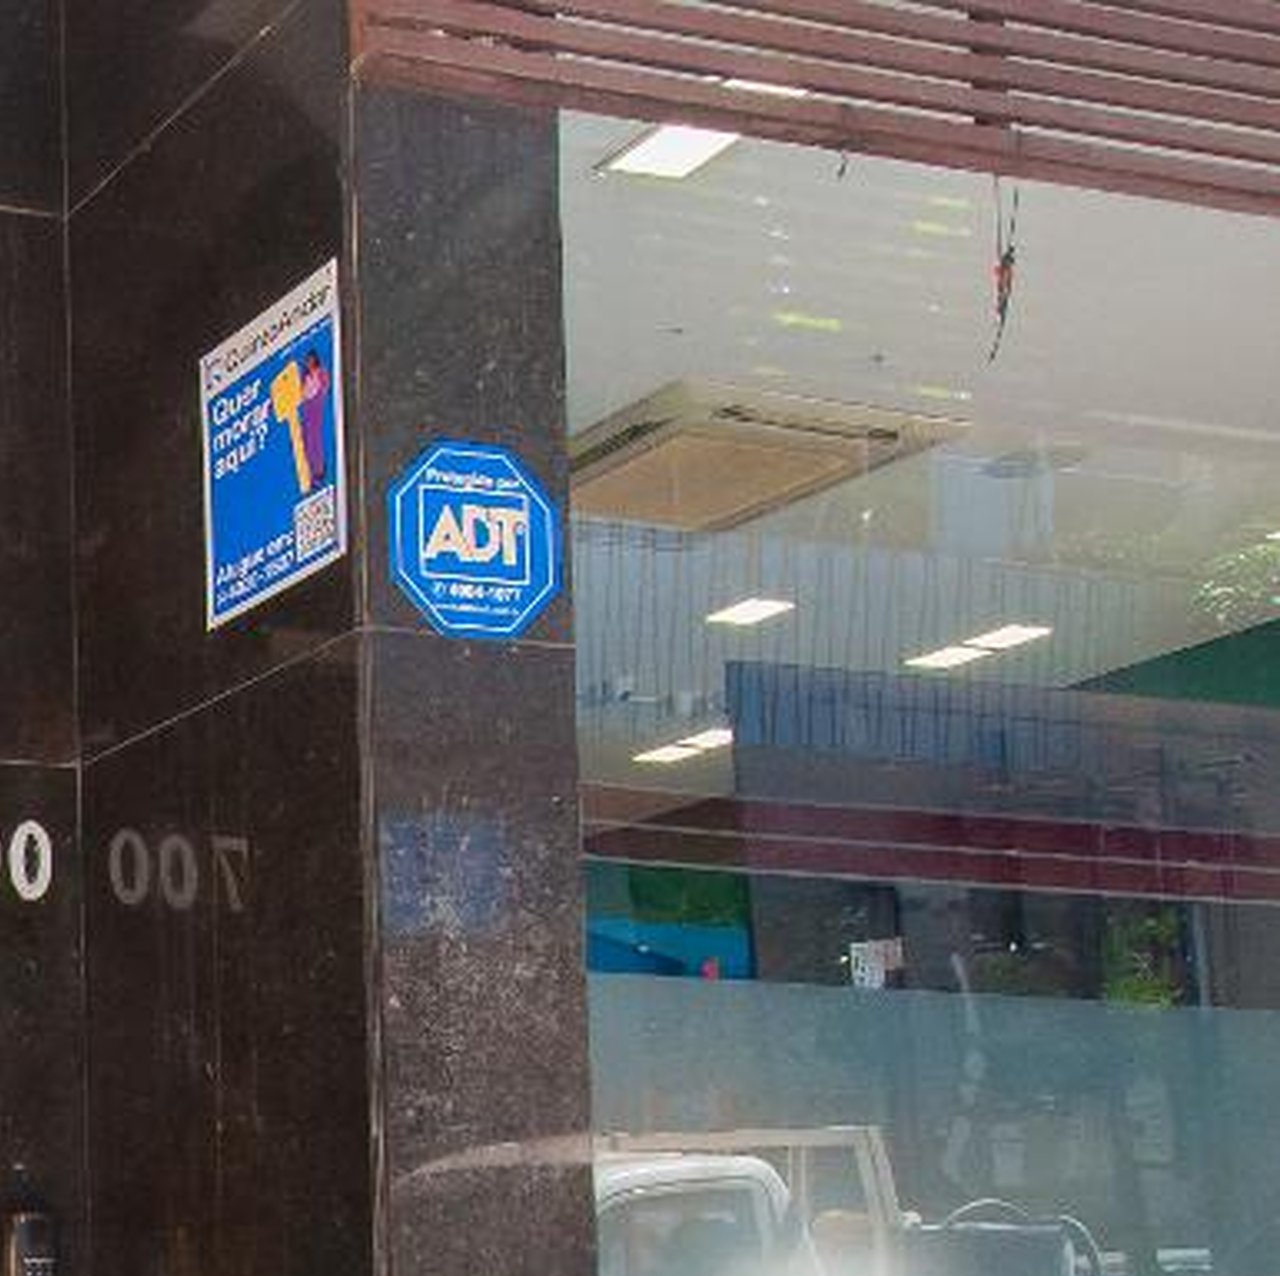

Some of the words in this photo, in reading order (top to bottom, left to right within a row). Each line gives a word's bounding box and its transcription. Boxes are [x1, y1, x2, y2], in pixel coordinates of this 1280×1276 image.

[212, 378, 262, 426] Quer
[213, 398, 273, 452] morar
[213, 422, 269, 479] aqui?
[425, 503, 527, 567] ADT
